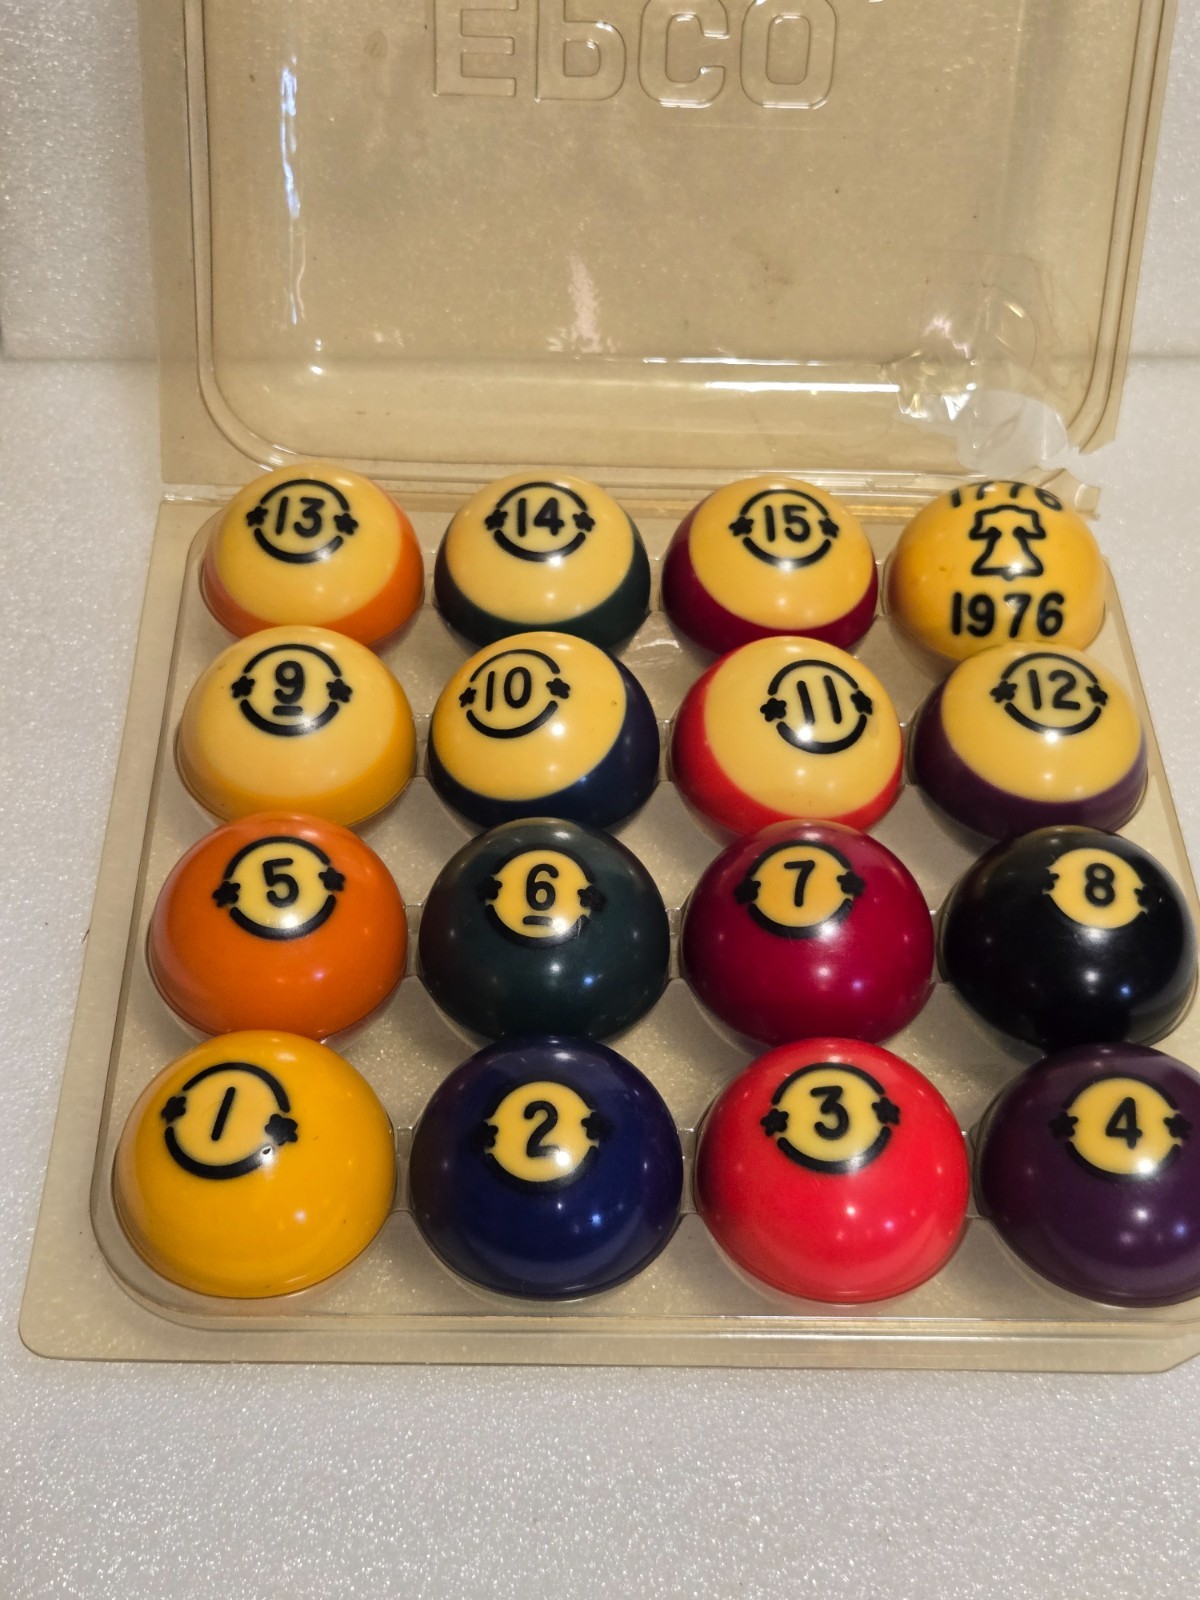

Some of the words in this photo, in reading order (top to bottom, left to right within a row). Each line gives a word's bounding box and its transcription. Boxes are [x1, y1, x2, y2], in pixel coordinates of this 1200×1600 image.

[275, 496, 325, 538] 13
[517, 497, 565, 537] 14
[764, 504, 811, 543] 15
[951, 591, 1065, 638] 1976
[272, 660, 307, 716] 9
[485, 666, 532, 712] 10
[796, 675, 842, 725] 11
[1028, 669, 1080, 710] 12
[262, 857, 299, 908] 5
[522, 863, 558, 926] 6
[783, 859, 815, 908] 7
[1084, 862, 1116, 908] 8
[210, 1086, 236, 1142] 1
[523, 1100, 559, 1158] 2
[810, 1085, 850, 1141] 3
[1105, 1096, 1143, 1150] 4
